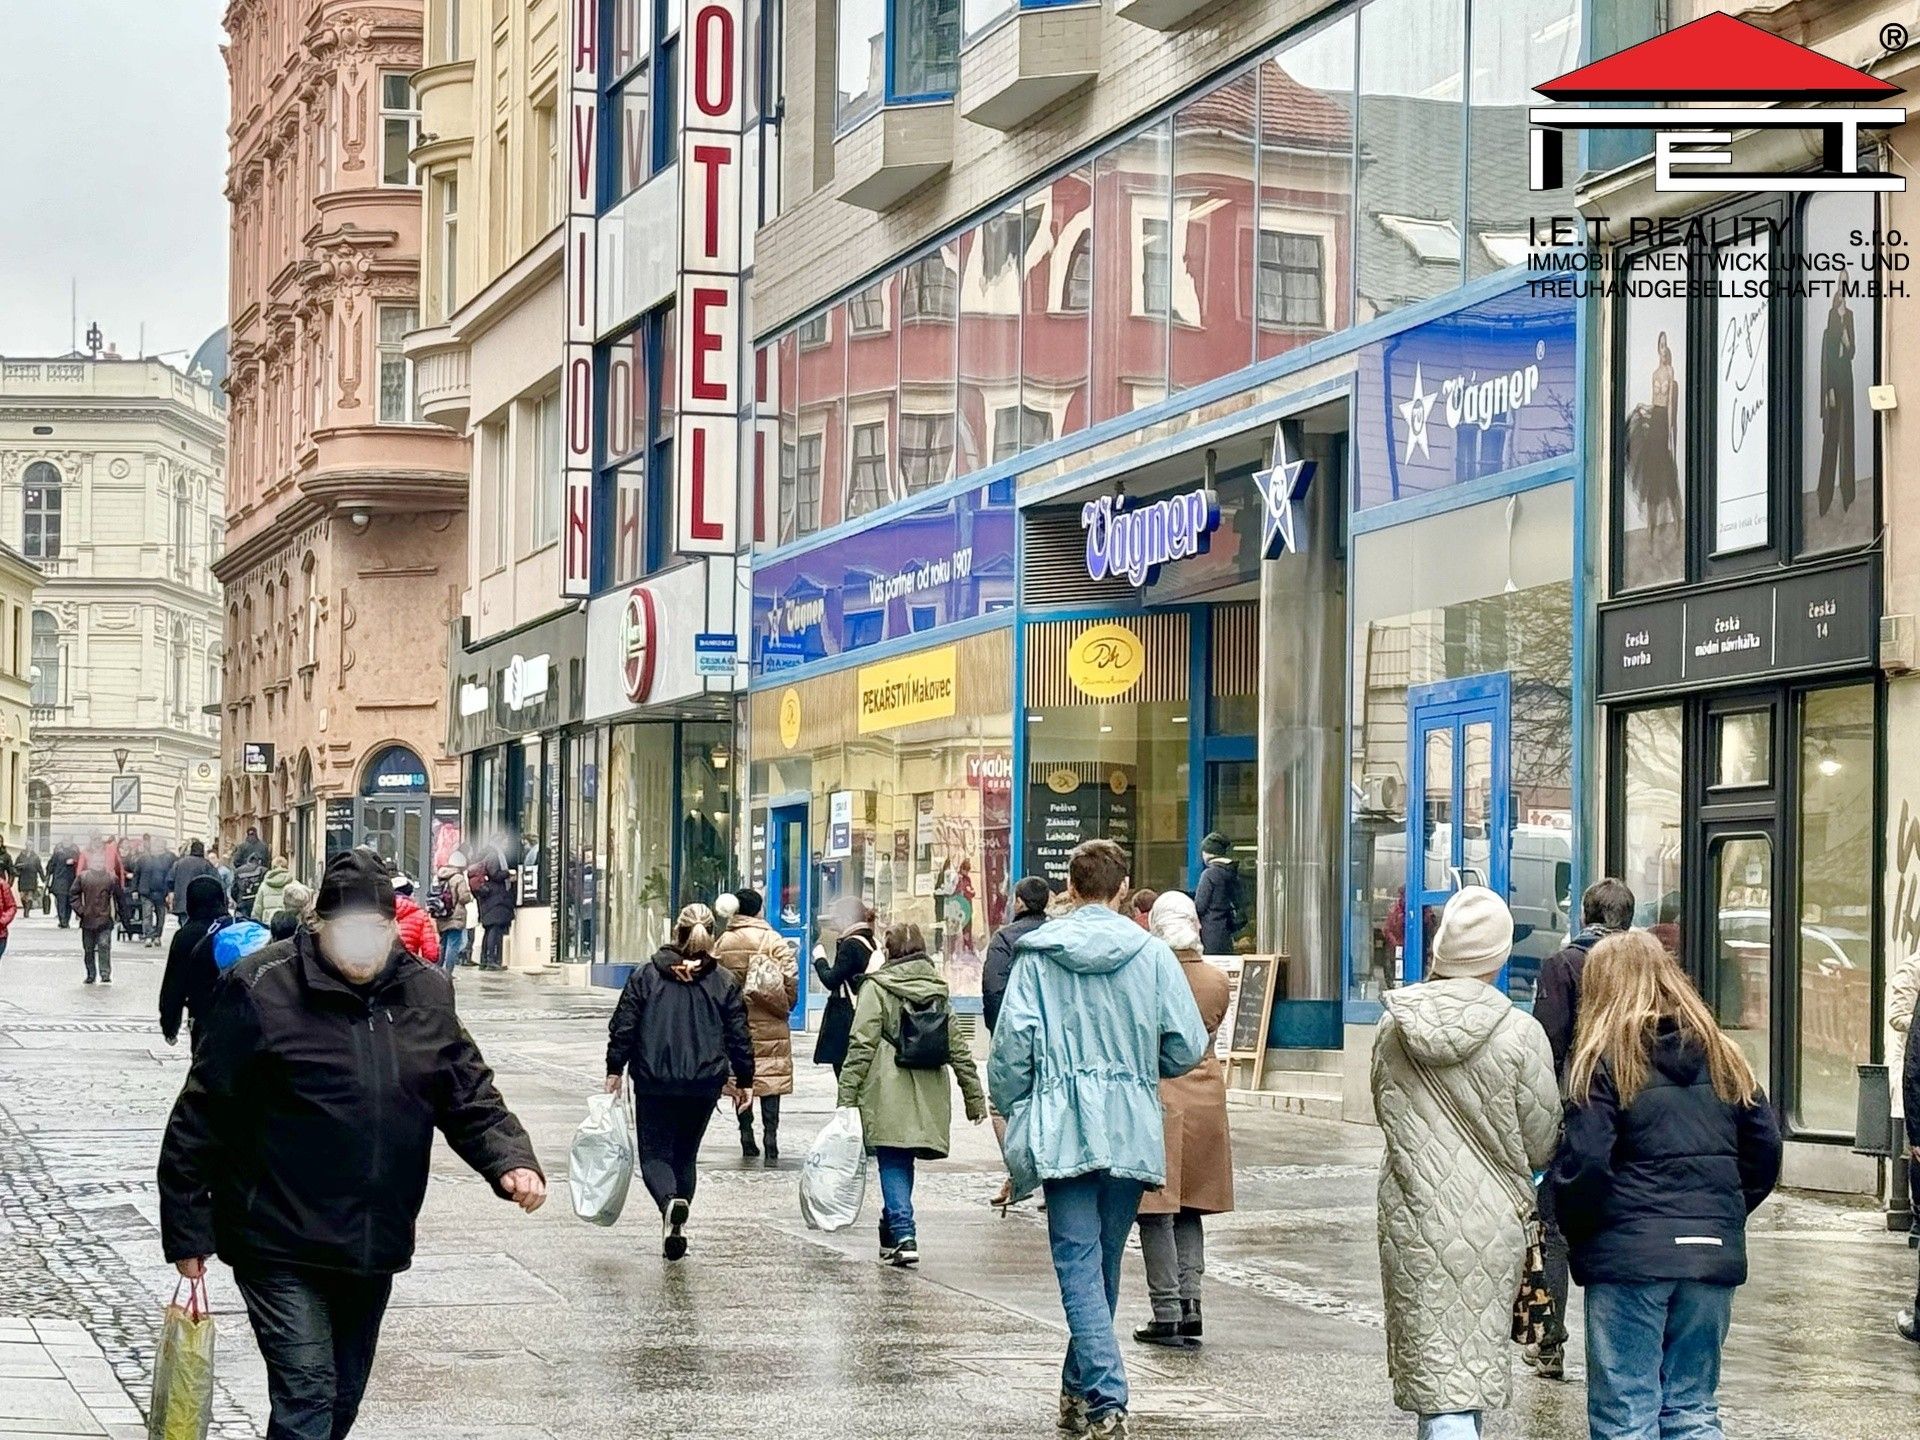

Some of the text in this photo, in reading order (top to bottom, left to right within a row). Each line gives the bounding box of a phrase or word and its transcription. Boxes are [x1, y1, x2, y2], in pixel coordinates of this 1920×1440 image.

[1081, 489, 1208, 587] Vágner
[868, 547, 973, 605] Váš partner od roku 1907
[1808, 599, 1837, 618] česká
[1715, 615, 1740, 633] česká
[1816, 622, 1829, 639] 14
[1625, 630, 1650, 648] česká
[1623, 651, 1651, 668] tvorba
[863, 674, 951, 715] PEKAŘSTVÍ Makovec
